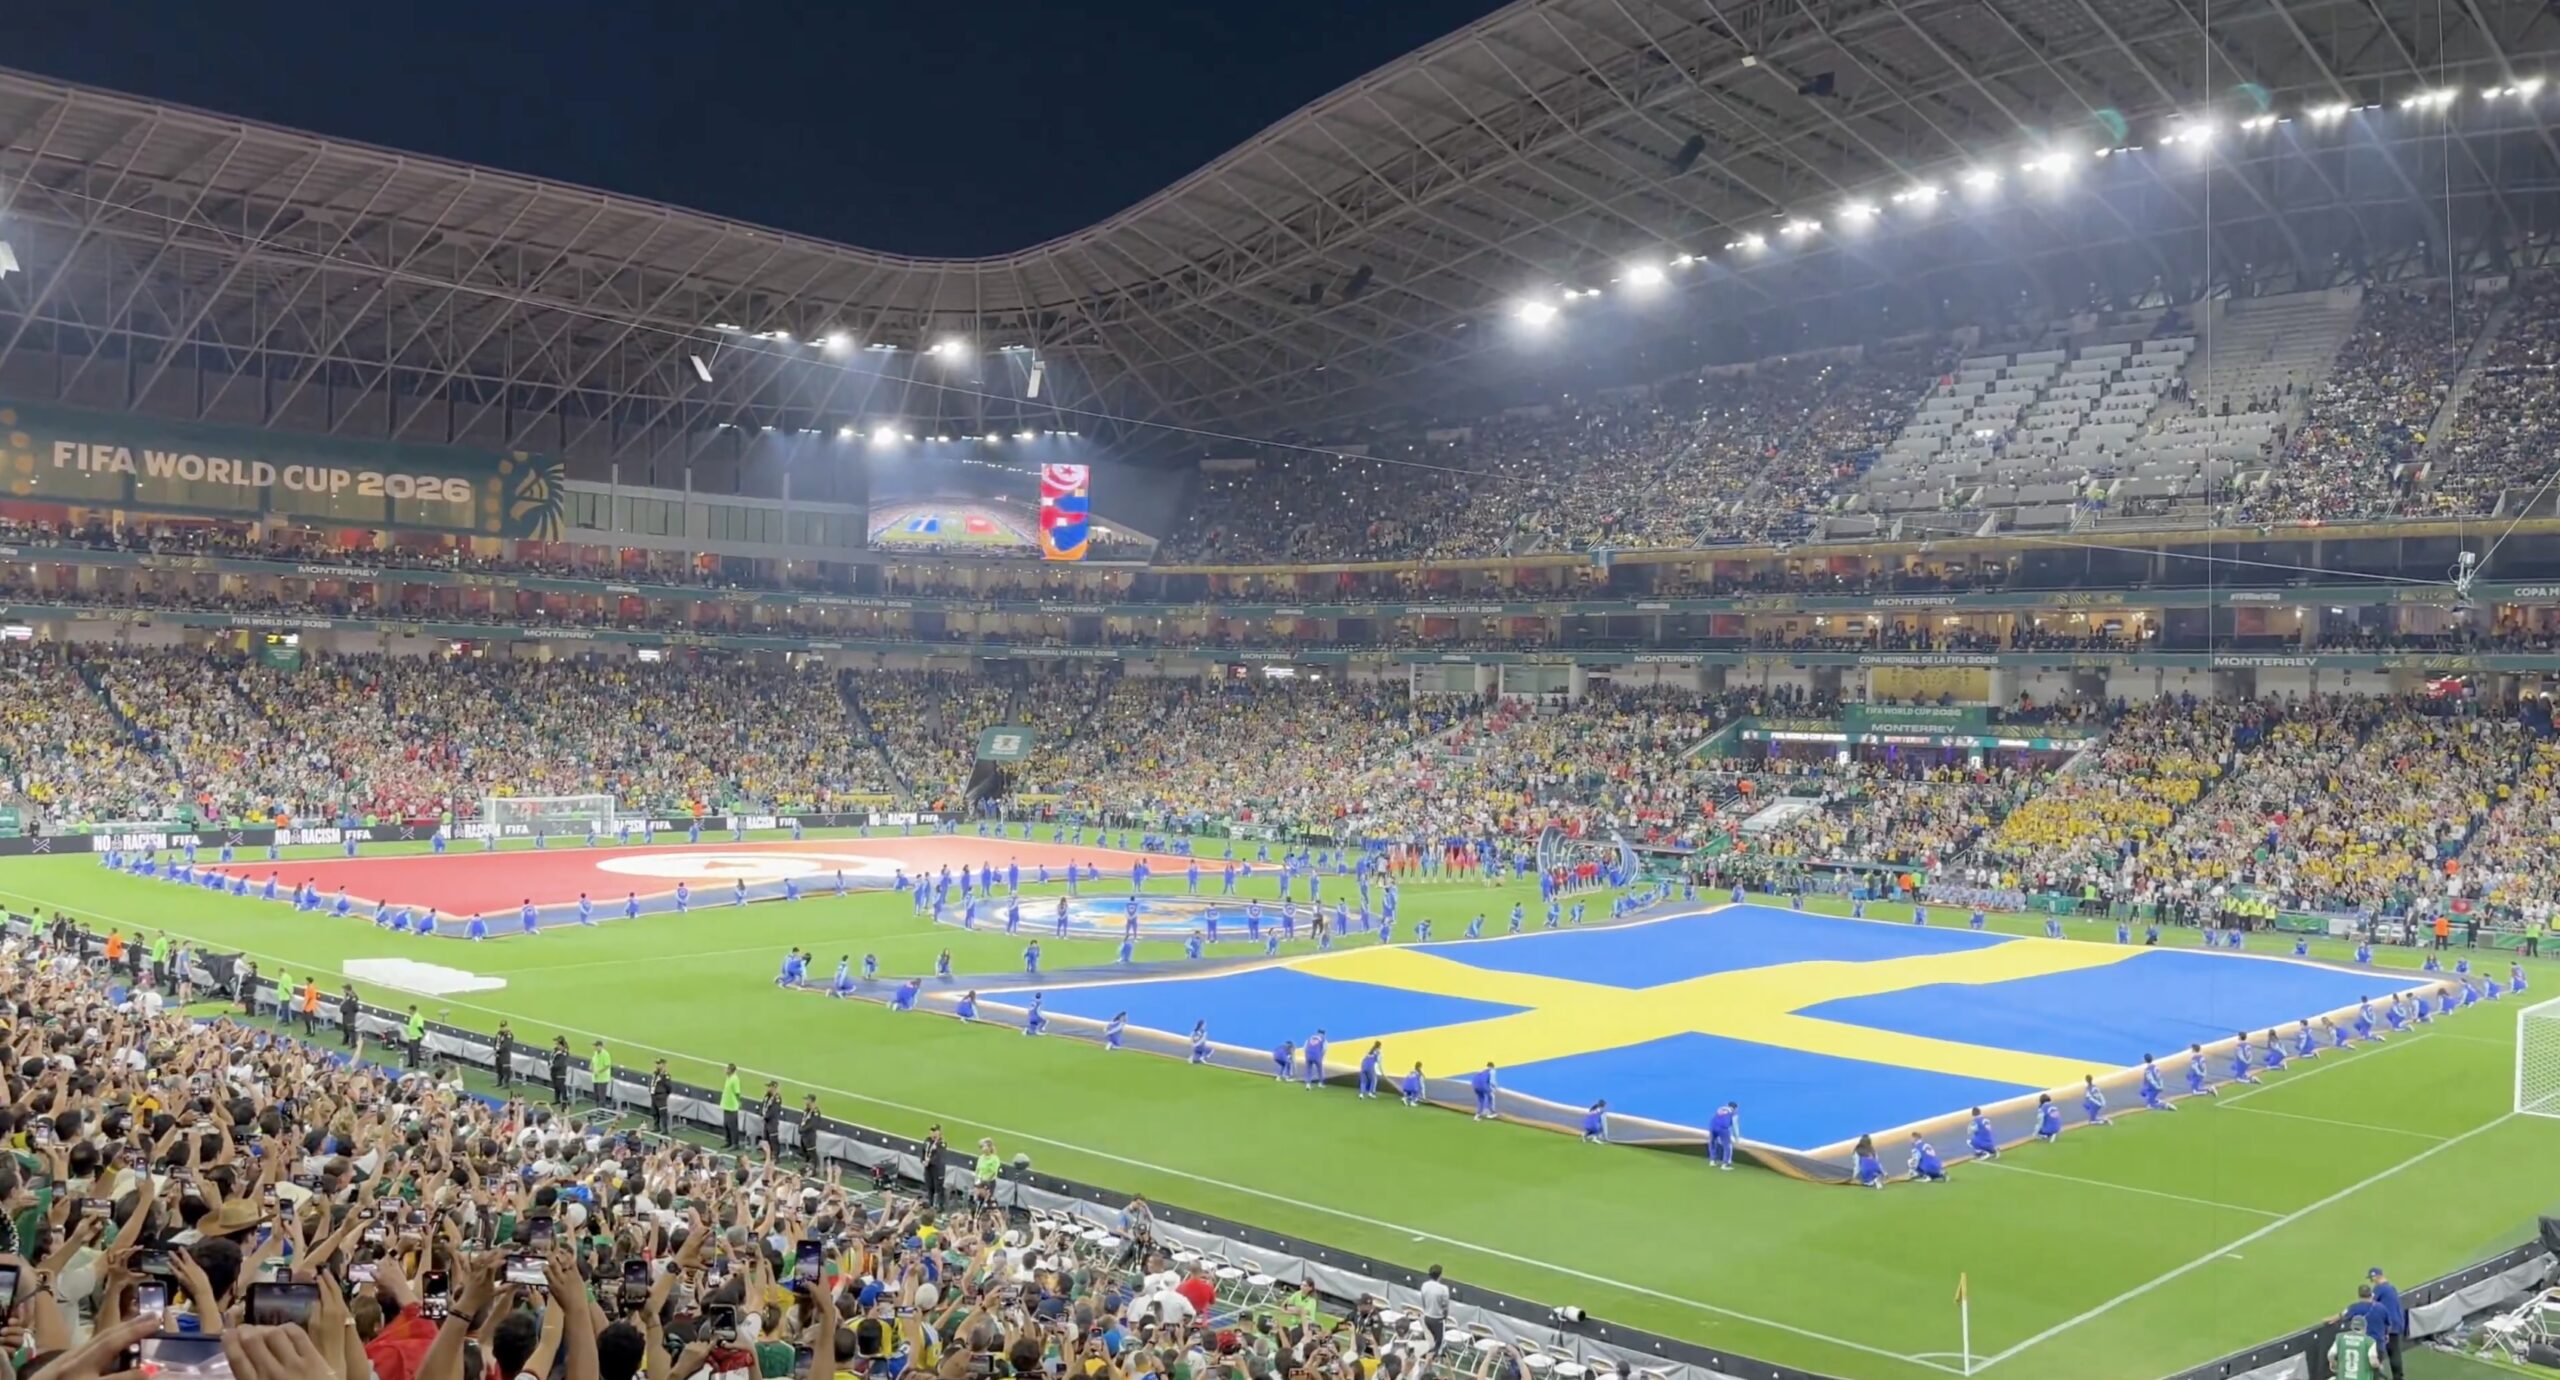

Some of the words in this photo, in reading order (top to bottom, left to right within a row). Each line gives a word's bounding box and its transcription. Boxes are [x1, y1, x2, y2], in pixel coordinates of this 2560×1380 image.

[53, 441, 136, 475] FIFA
[143, 449, 276, 488] WORLD
[283, 465, 351, 493] CUP
[357, 471, 472, 503] 2026
[298, 566, 379, 577] MONTERREY
[2514, 588, 2547, 597] COPA
[1873, 597, 1956, 606] MONTERREY
[232, 617, 251, 625] FIFA
[252, 618, 283, 626] WORLD
[302, 620, 332, 628] 2026
[524, 629, 595, 639] MONTERREY
[1634, 655, 1703, 663] MONTERREY
[1859, 655, 1881, 664] COPA
[1882, 656, 1920, 664] MUNDIAL
[1921, 656, 1933, 664] DE
[1934, 656, 1946, 664] LA
[1947, 656, 1966, 664] FIFA
[1967, 656, 1999, 664] 2026
[2214, 657, 2317, 667] MONTERREY
[1865, 706, 1883, 714] FIFA
[1884, 707, 1914, 715] WORLD
[1914, 708, 1932, 716] CUP
[1932, 708, 1962, 717] 2026
[1871, 723, 1956, 733] MONTERREY
[505, 824, 530, 834] FIFA
[275, 830, 291, 845] NO
[300, 827, 341, 844] RACISM
[345, 829, 372, 840] FIFA
[94, 834, 111, 852] NO
[123, 833, 168, 851] RACISM
[172, 834, 201, 846] FIFA
